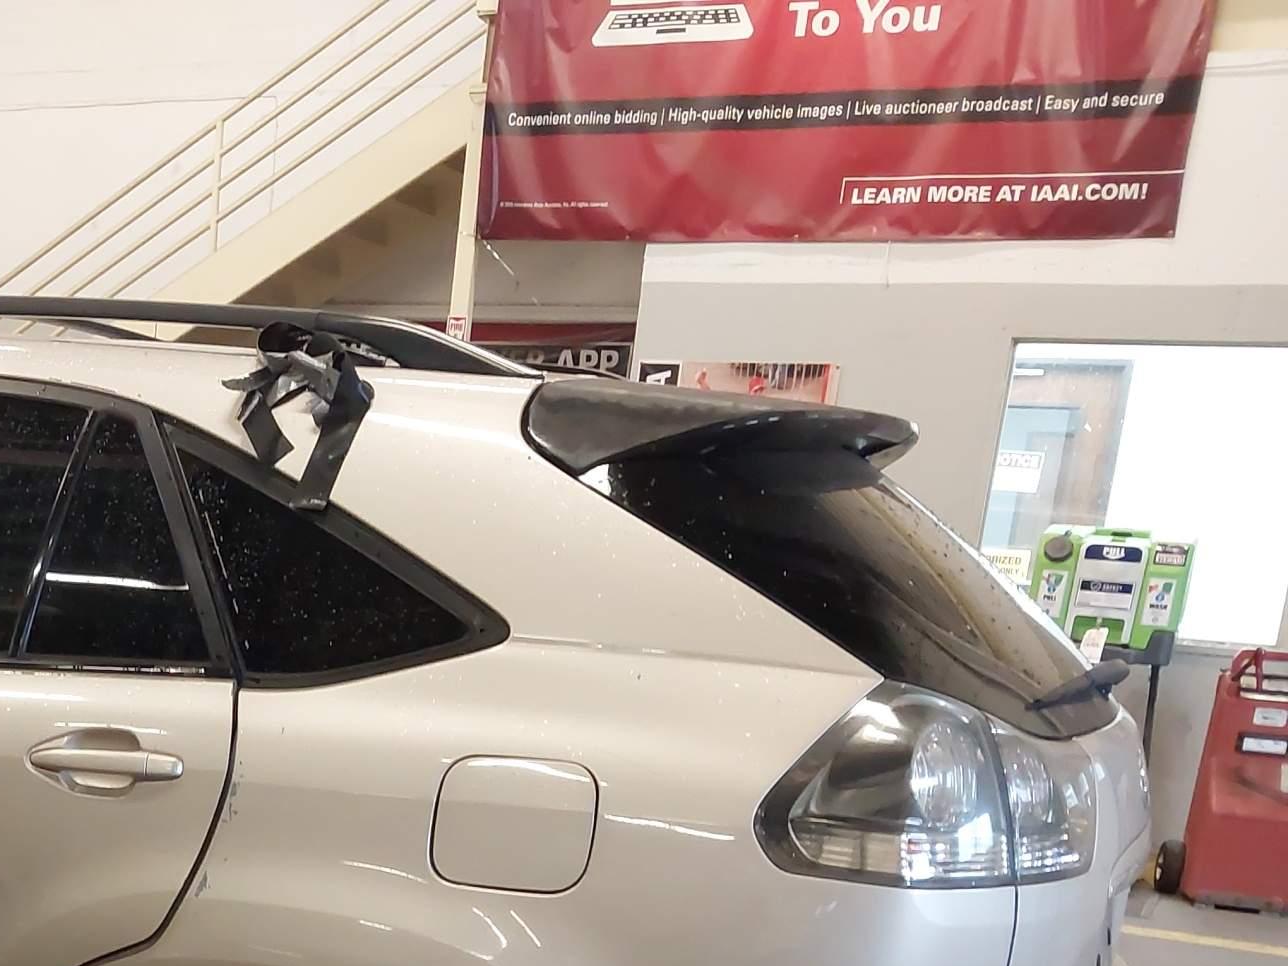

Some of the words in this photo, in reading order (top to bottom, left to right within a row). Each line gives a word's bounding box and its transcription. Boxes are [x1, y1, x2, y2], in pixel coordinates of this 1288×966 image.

[788, 1, 840, 38] To
[855, 0, 942, 34] You
[508, 111, 571, 127] Convenient
[574, 110, 611, 125] online
[614, 109, 658, 126] bidding
[668, 105, 744, 125] High-quality
[747, 104, 793, 121] vehicle
[796, 103, 843, 121] images
[854, 99, 882, 116] Live
[885, 100, 959, 116] auctioneer
[961, 96, 1033, 112] broadcast
[1044, 94, 1079, 113] Easy
[1082, 91, 1109, 110] and
[1111, 92, 1165, 108] secure
[850, 186, 921, 205] LEARN
[927, 185, 993, 203] MORE
[995, 185, 1026, 202] AT
[1030, 182, 1149, 202] IAAI.COM!
[557, 349, 619, 371] APP
